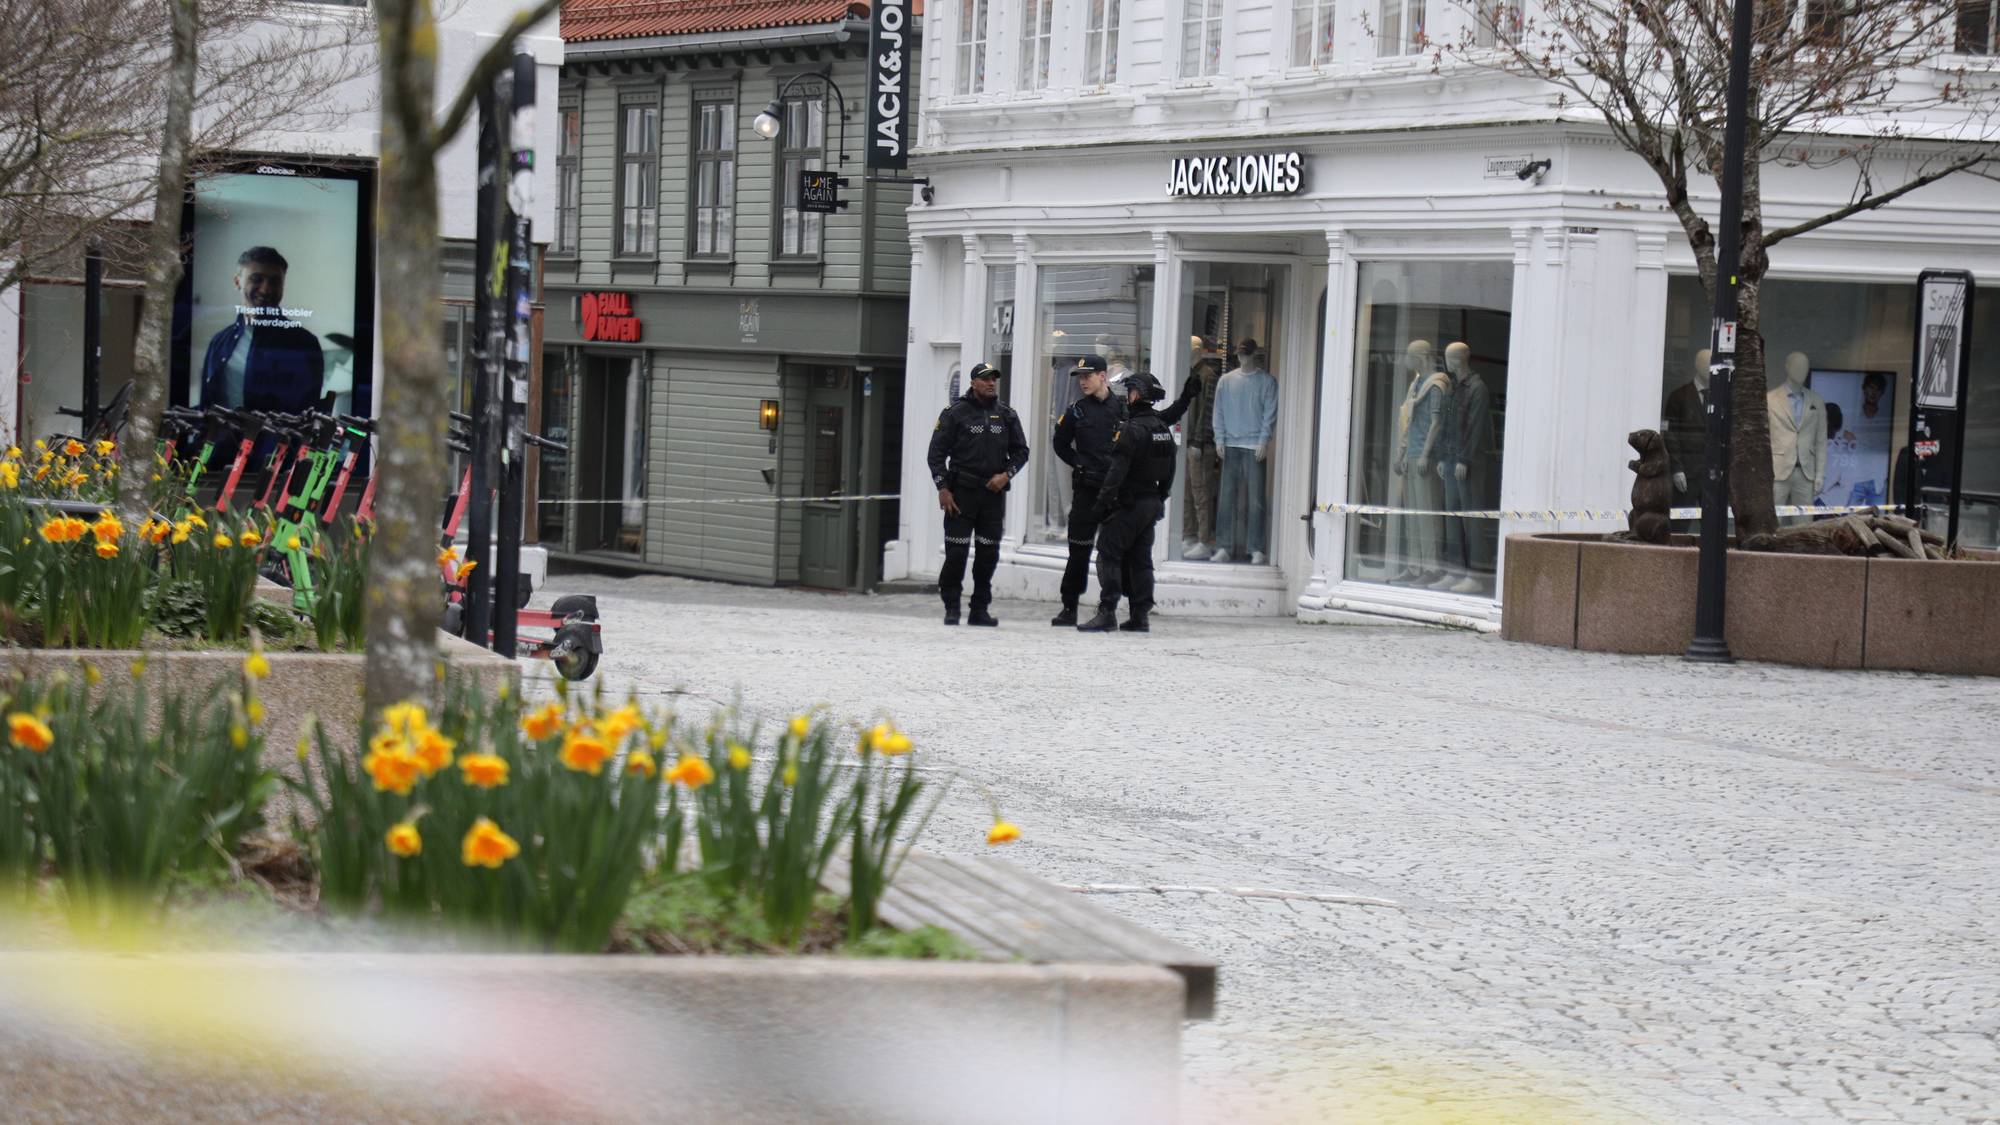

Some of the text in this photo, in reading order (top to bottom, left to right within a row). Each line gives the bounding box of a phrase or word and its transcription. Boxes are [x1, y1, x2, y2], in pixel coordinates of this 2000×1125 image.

[877, 0, 904, 157] JACK&JO
[1165, 152, 1300, 196] JACK&JONES
[803, 187, 833, 201] AGAIN
[235, 305, 313, 317] Tilsett litt bobler
[250, 319, 302, 328] hverdagen
